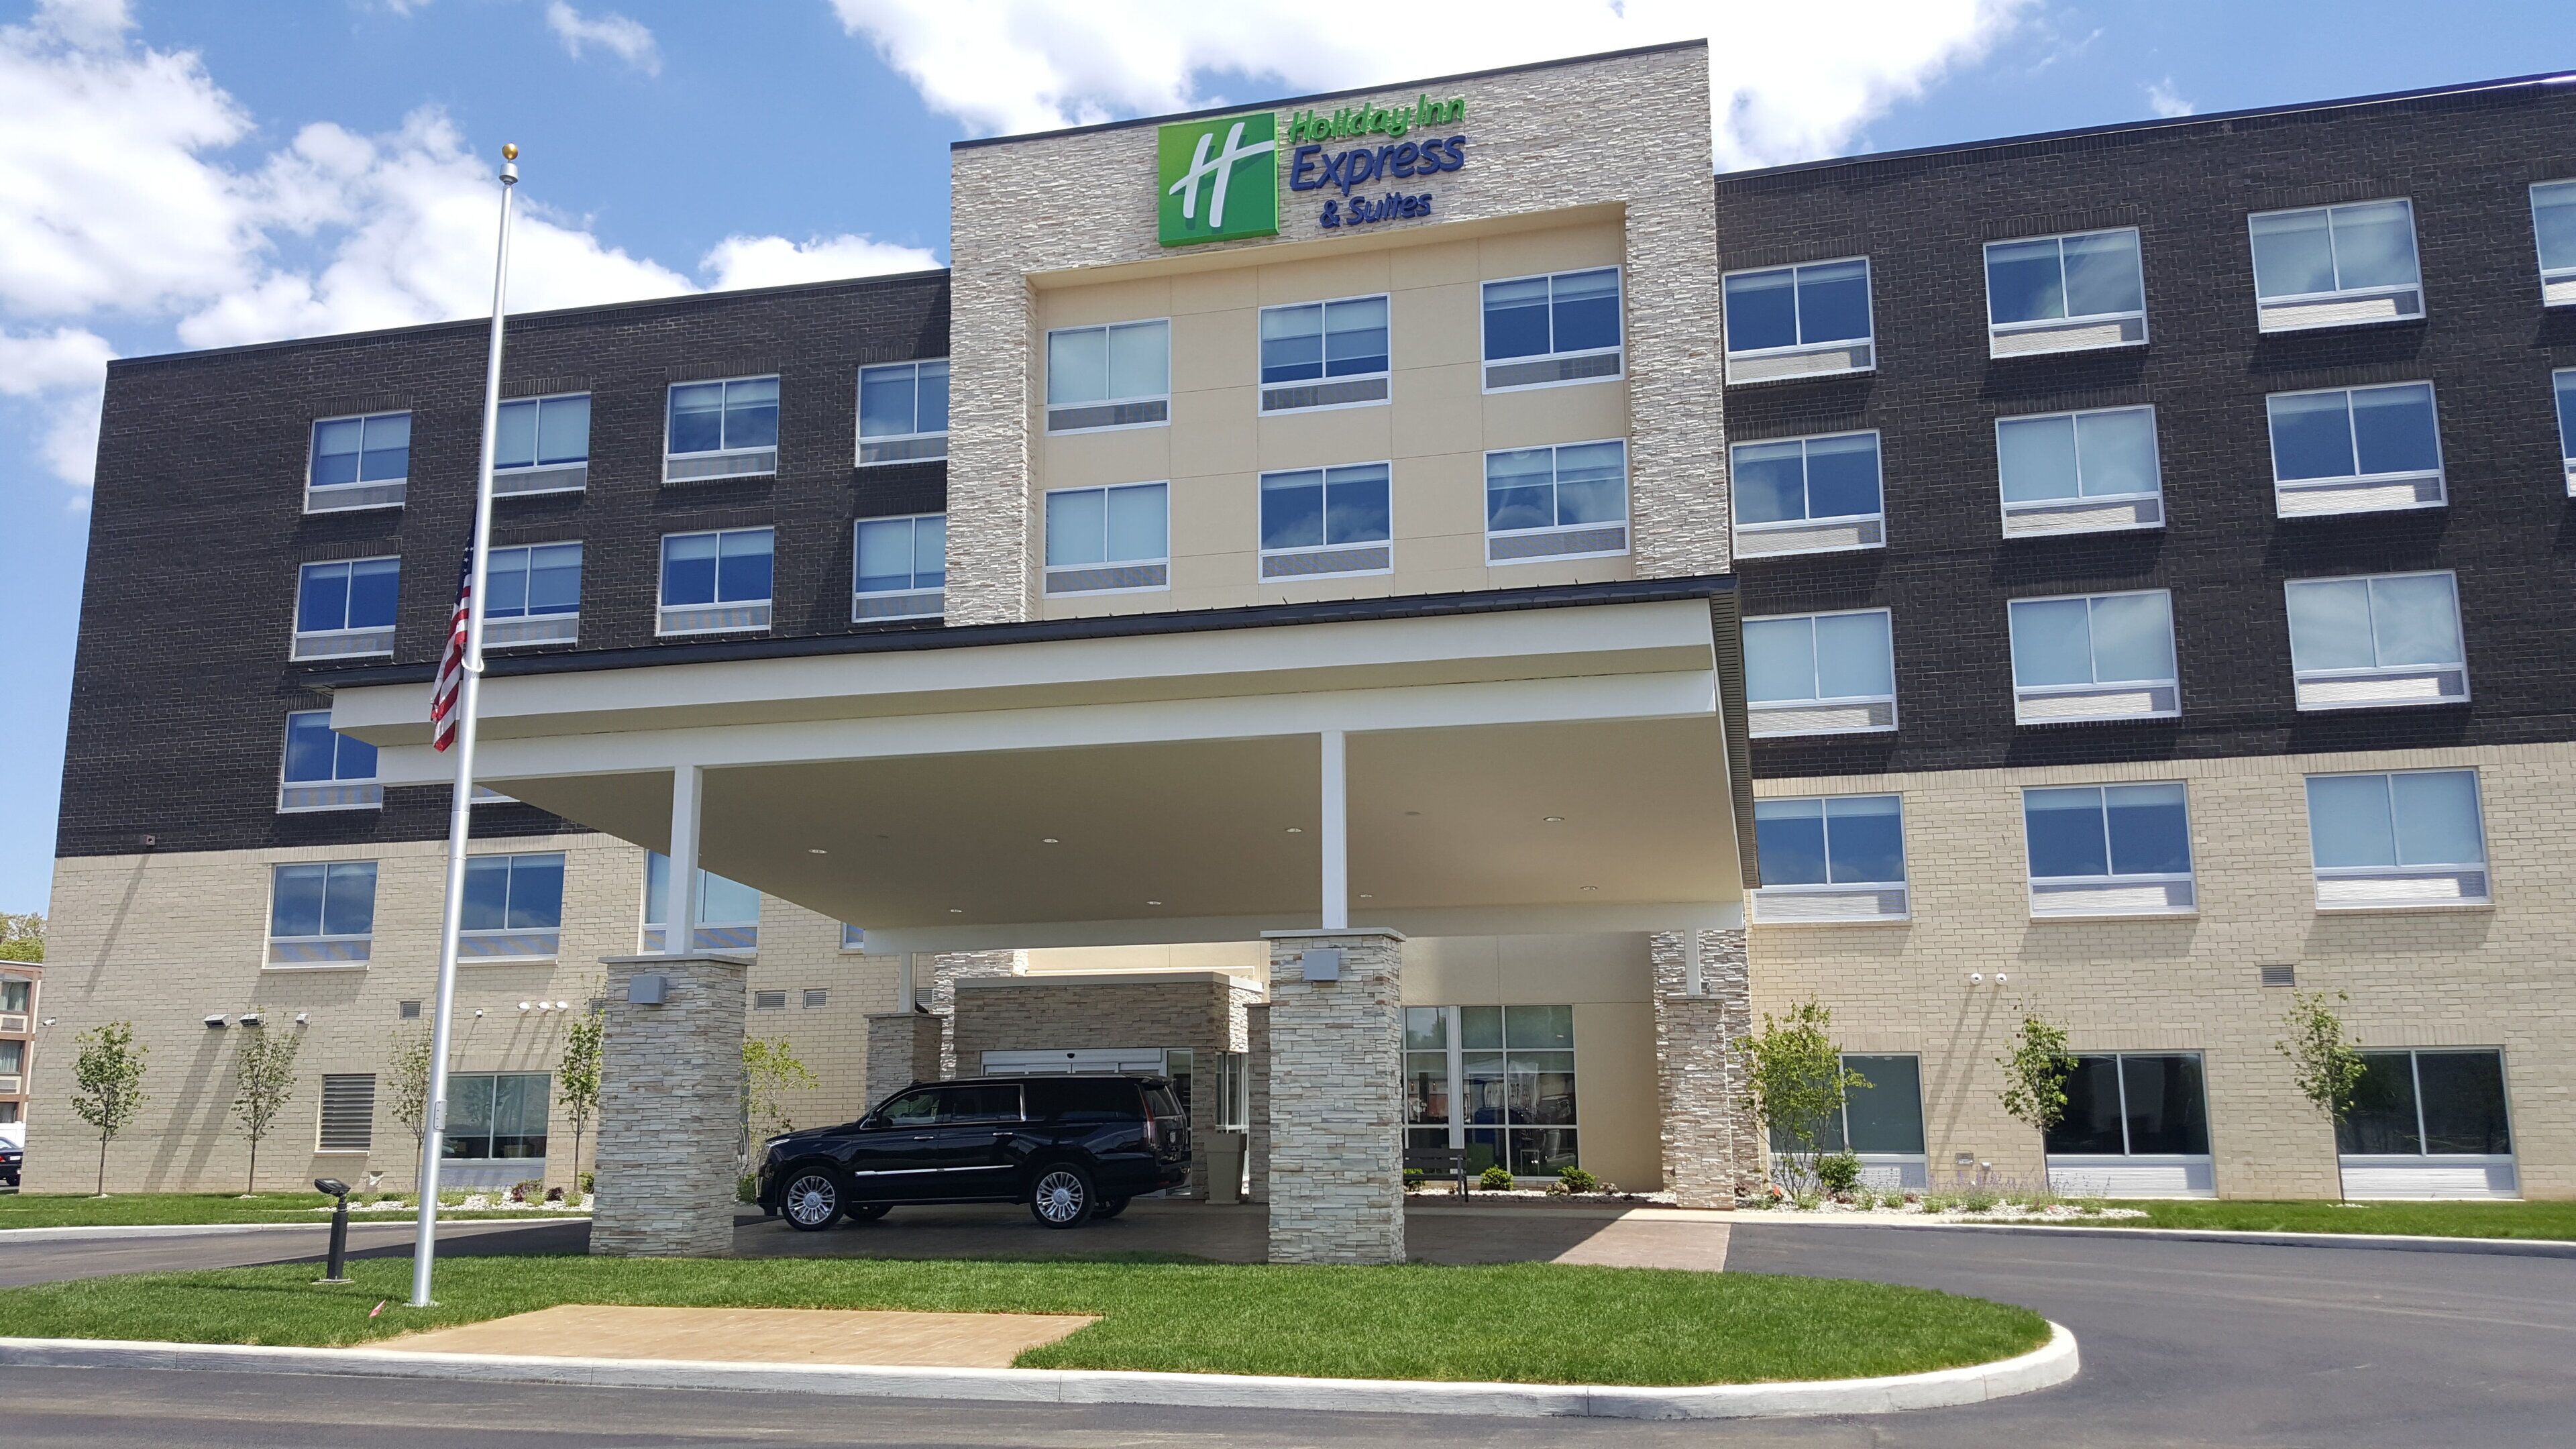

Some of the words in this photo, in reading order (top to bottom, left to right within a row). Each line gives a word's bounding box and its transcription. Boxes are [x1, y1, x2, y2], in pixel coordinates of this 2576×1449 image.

[1288, 102, 1410, 145] Holiday
[1415, 93, 1465, 126] Inn
[1289, 135, 1466, 197] Express
[1320, 199, 1340, 229] &
[1346, 192, 1433, 225] Suites
